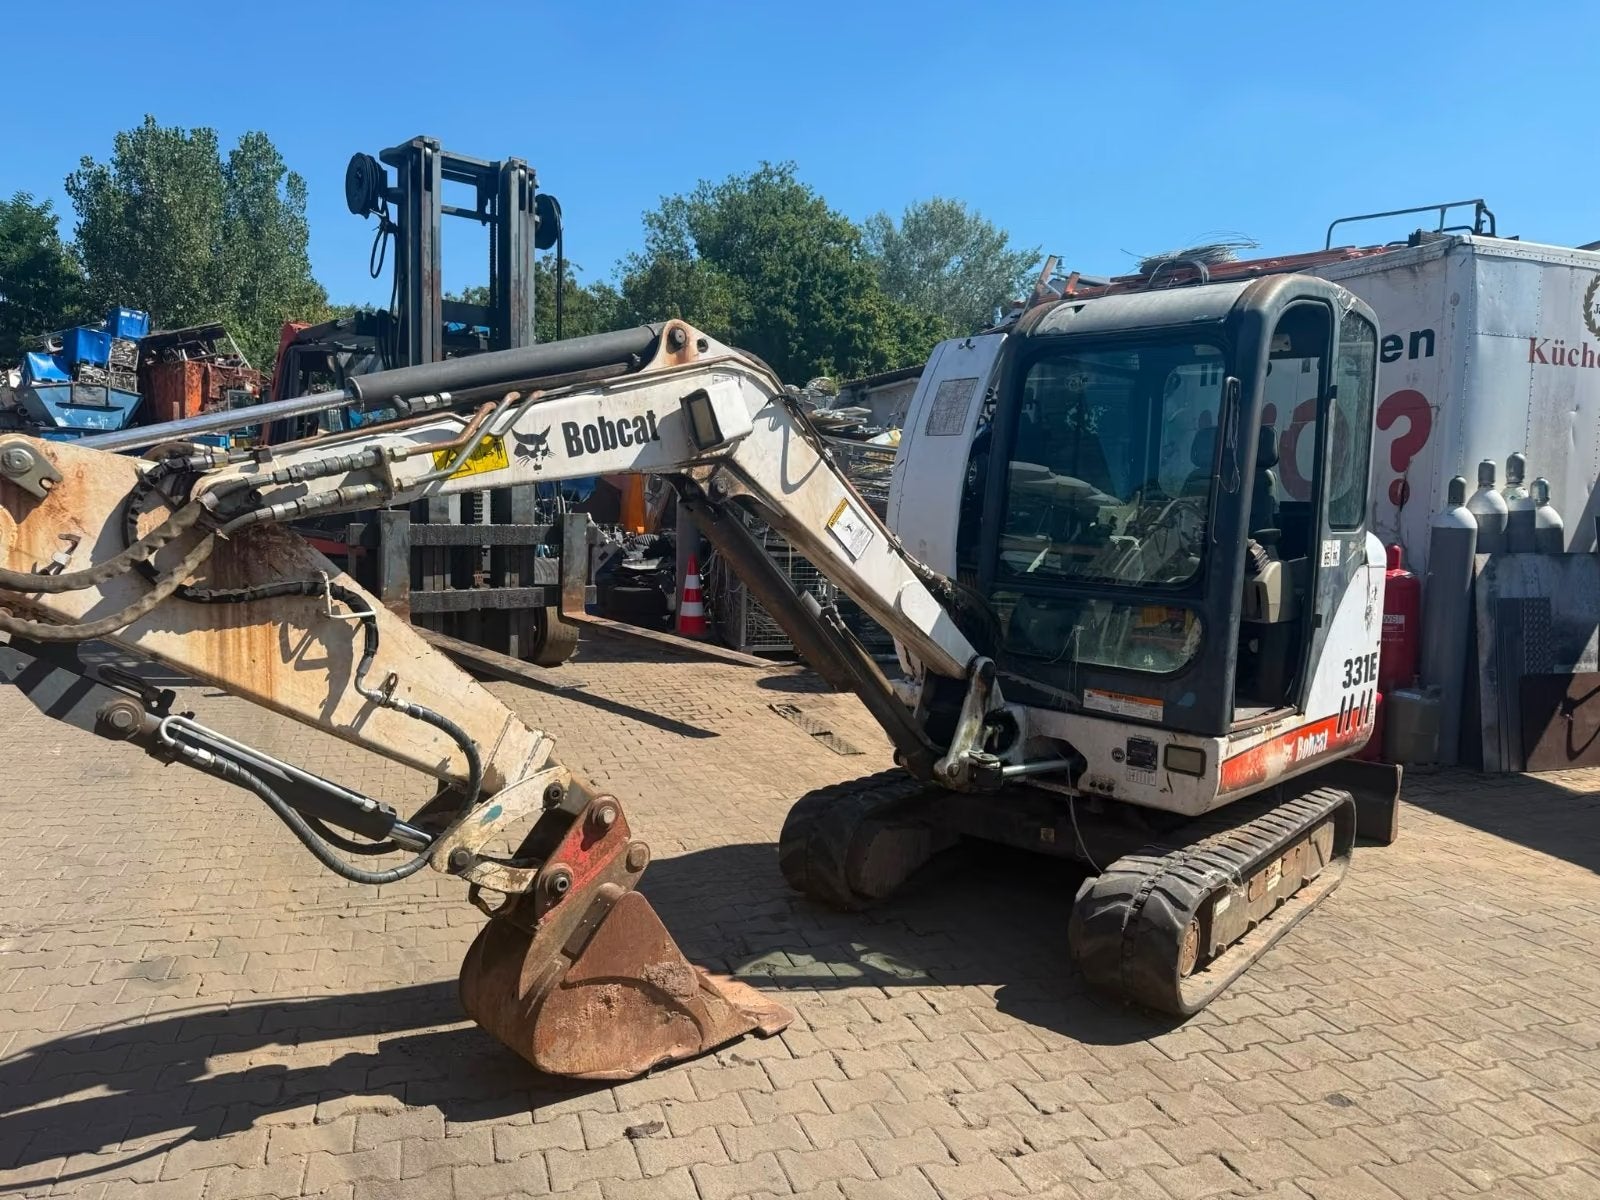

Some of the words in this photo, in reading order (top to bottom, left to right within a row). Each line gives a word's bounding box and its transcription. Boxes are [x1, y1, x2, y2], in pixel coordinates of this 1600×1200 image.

[561, 410, 660, 458] Bobcat
[1342, 652, 1377, 689] 331E
[1295, 728, 1329, 762] Bobcat
